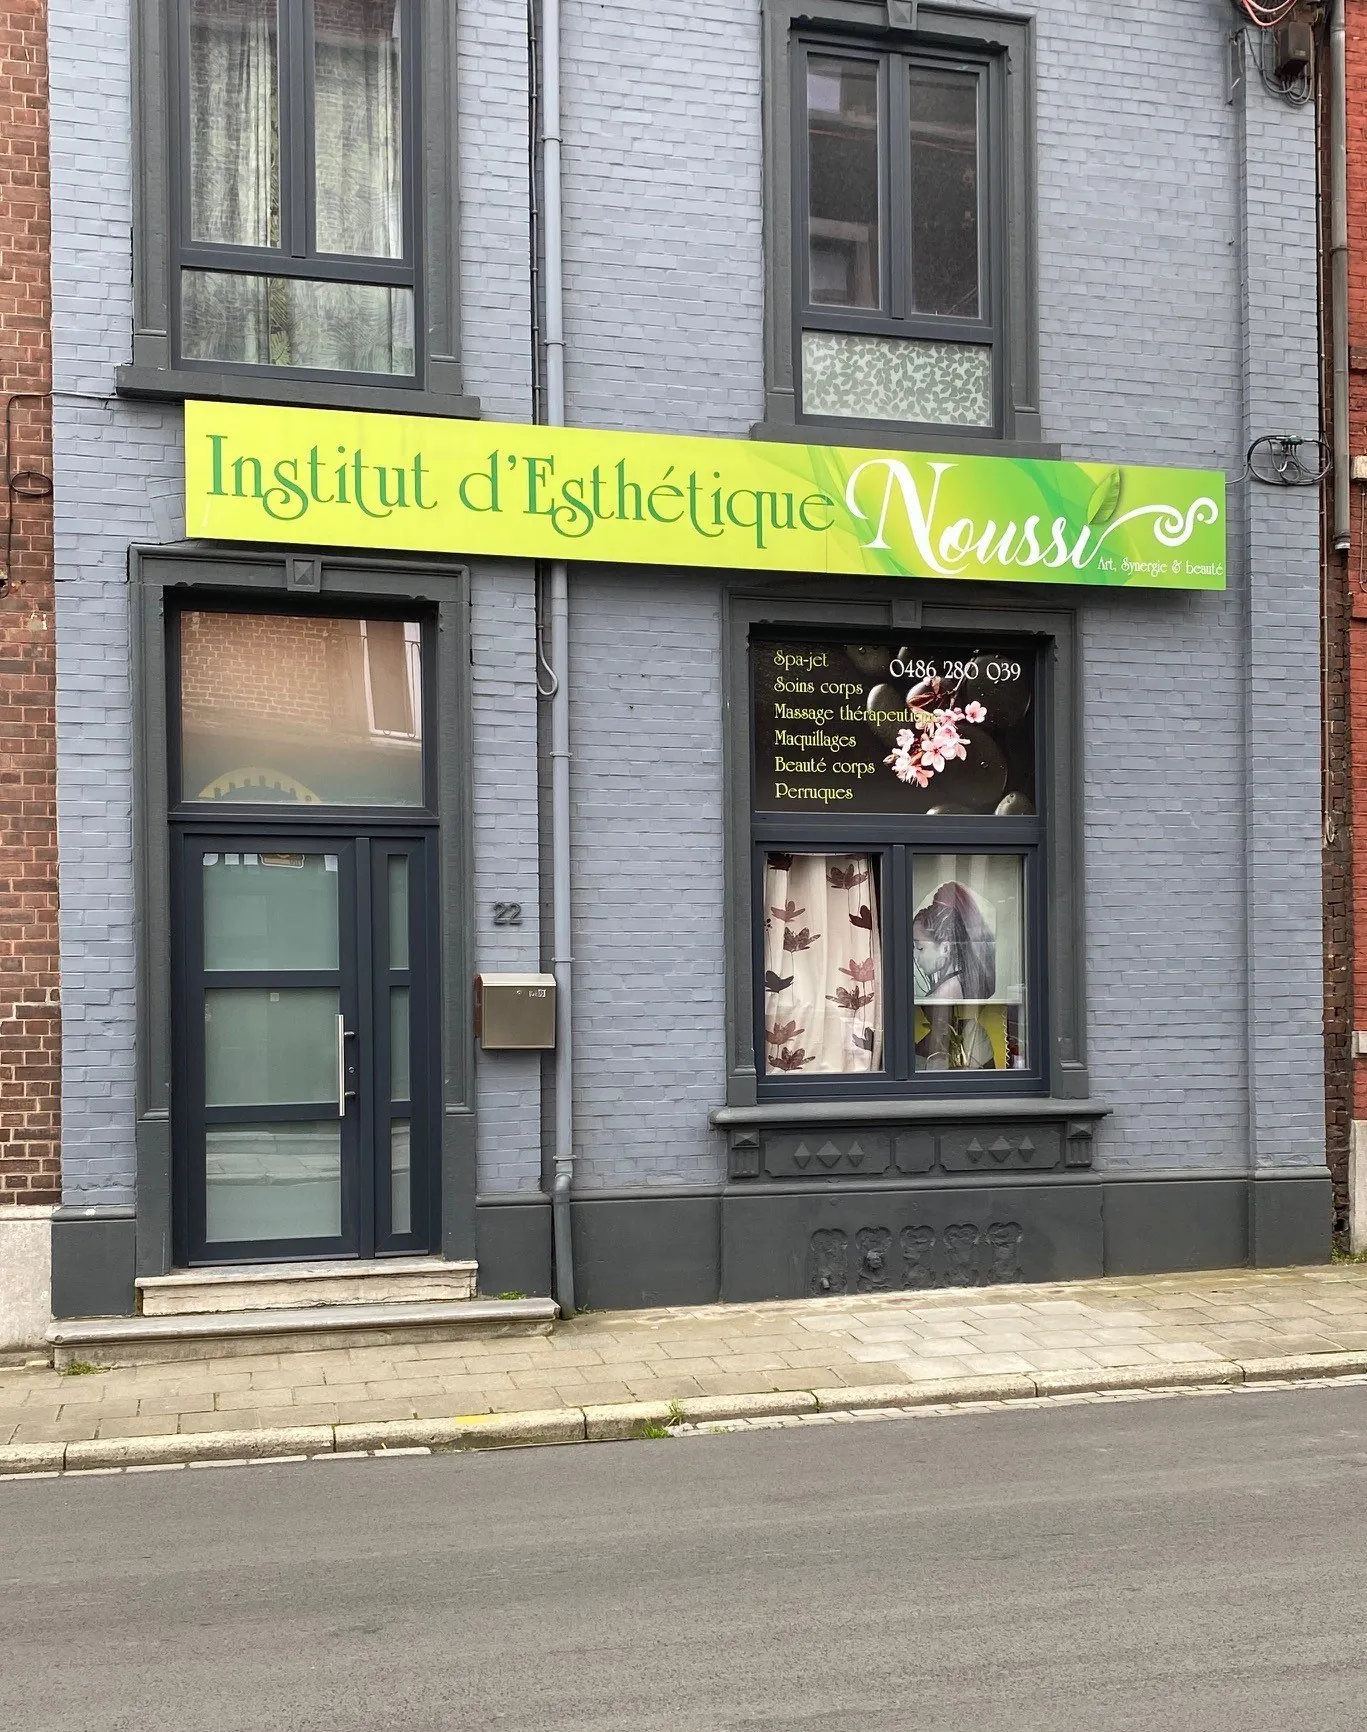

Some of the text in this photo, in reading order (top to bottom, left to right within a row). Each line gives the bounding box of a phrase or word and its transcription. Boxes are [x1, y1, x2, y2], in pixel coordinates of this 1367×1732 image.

[206, 433, 438, 520] Institut
[845, 458, 1112, 575] Noussi
[1097, 556, 1224, 578] Art, Synergie & beauté
[773, 649, 830, 672] Spa-jet
[889, 659, 1021, 682] 0486 280 039
[773, 676, 864, 700] Soins corps
[774, 702, 834, 726] Massage
[774, 729, 857, 753] Maquillages
[774, 756, 876, 779] Beauté corps
[774, 782, 854, 805] Perruques
[493, 902, 522, 926] 22
